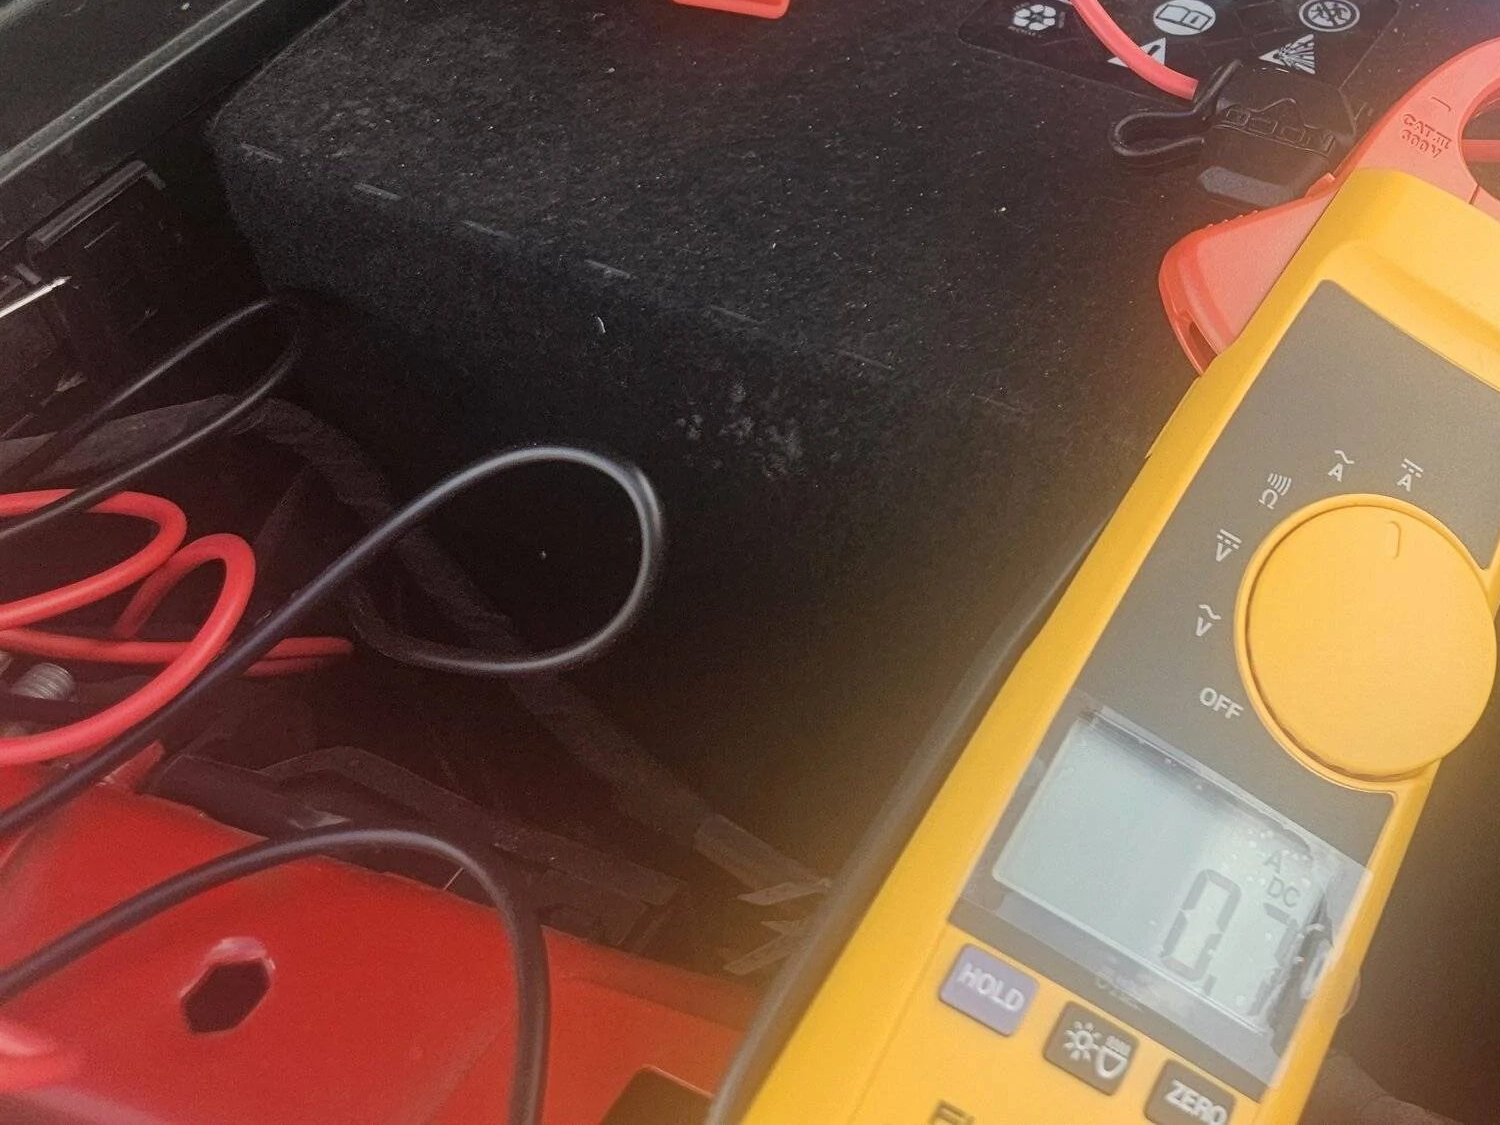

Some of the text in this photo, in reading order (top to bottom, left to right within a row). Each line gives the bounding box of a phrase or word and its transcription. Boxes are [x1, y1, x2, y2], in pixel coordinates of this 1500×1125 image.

[1403, 113, 1437, 137] CAT
[1199, 686, 1245, 720] OFF
[1266, 876, 1301, 909] DC
[958, 962, 1025, 1012] HOLD
[1164, 1079, 1229, 1125] ZERO
